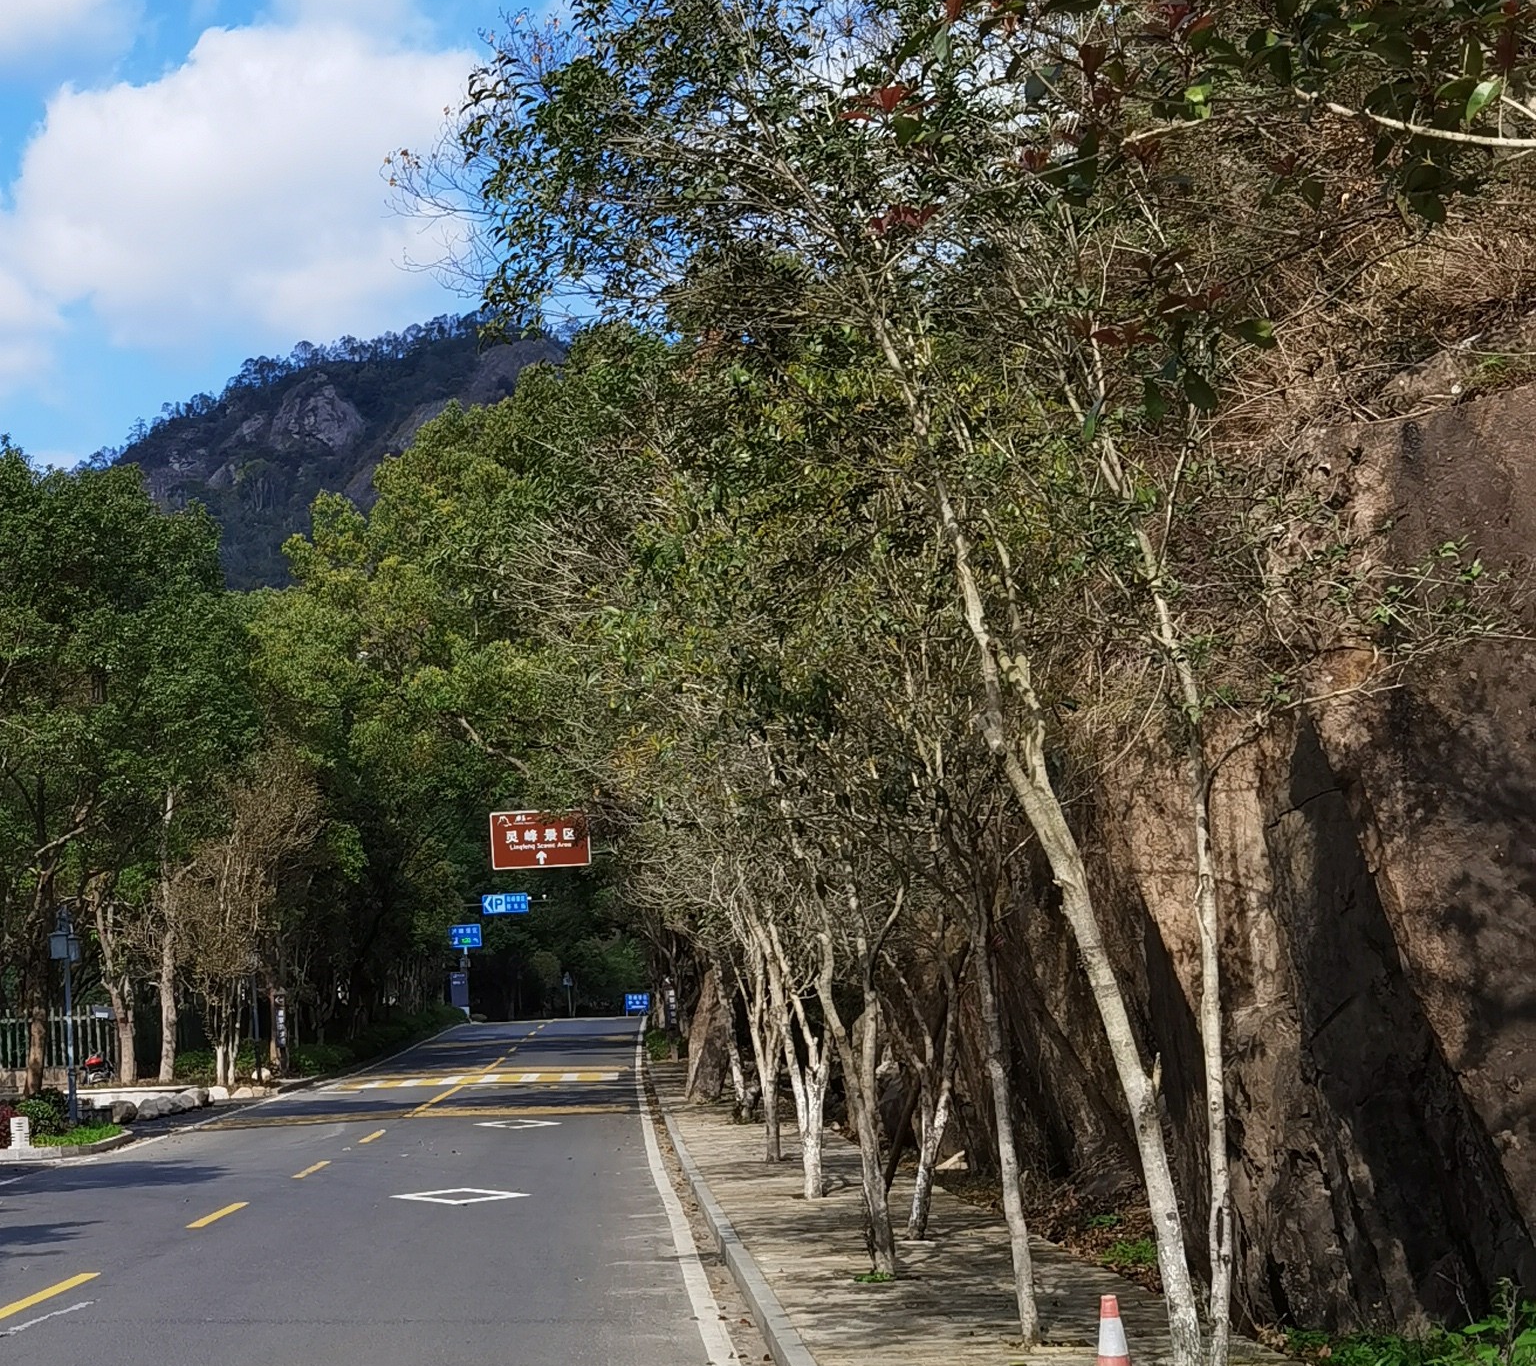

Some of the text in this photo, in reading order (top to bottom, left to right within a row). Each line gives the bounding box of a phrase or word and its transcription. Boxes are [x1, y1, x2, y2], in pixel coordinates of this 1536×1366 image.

[505, 828, 576, 844] 灵峰景区
[495, 898, 503, 910] P
